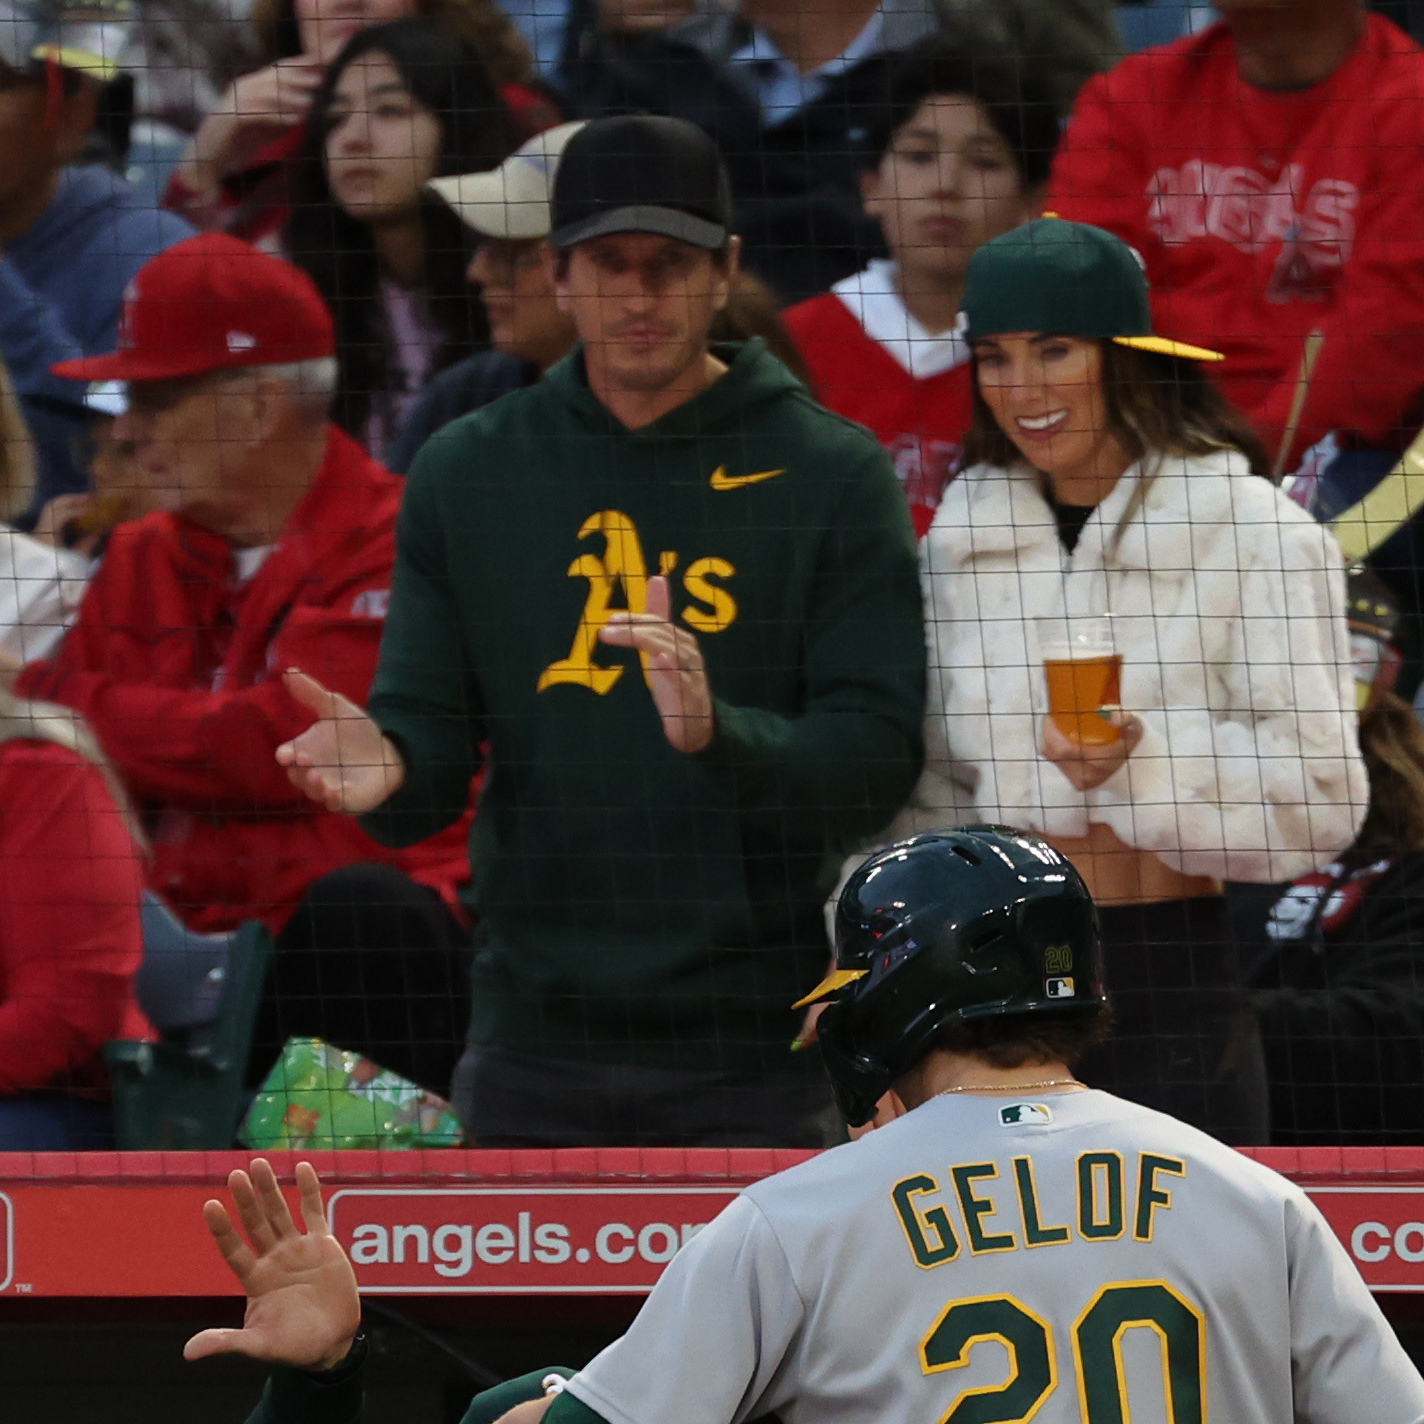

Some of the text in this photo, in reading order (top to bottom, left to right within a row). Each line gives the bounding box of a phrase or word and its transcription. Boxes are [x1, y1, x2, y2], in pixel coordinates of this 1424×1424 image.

[537, 509, 738, 696] A's
[1045, 945, 1073, 974] 20
[350, 1211, 708, 1277] angels.co
[890, 1148, 1186, 1269] GELOF
